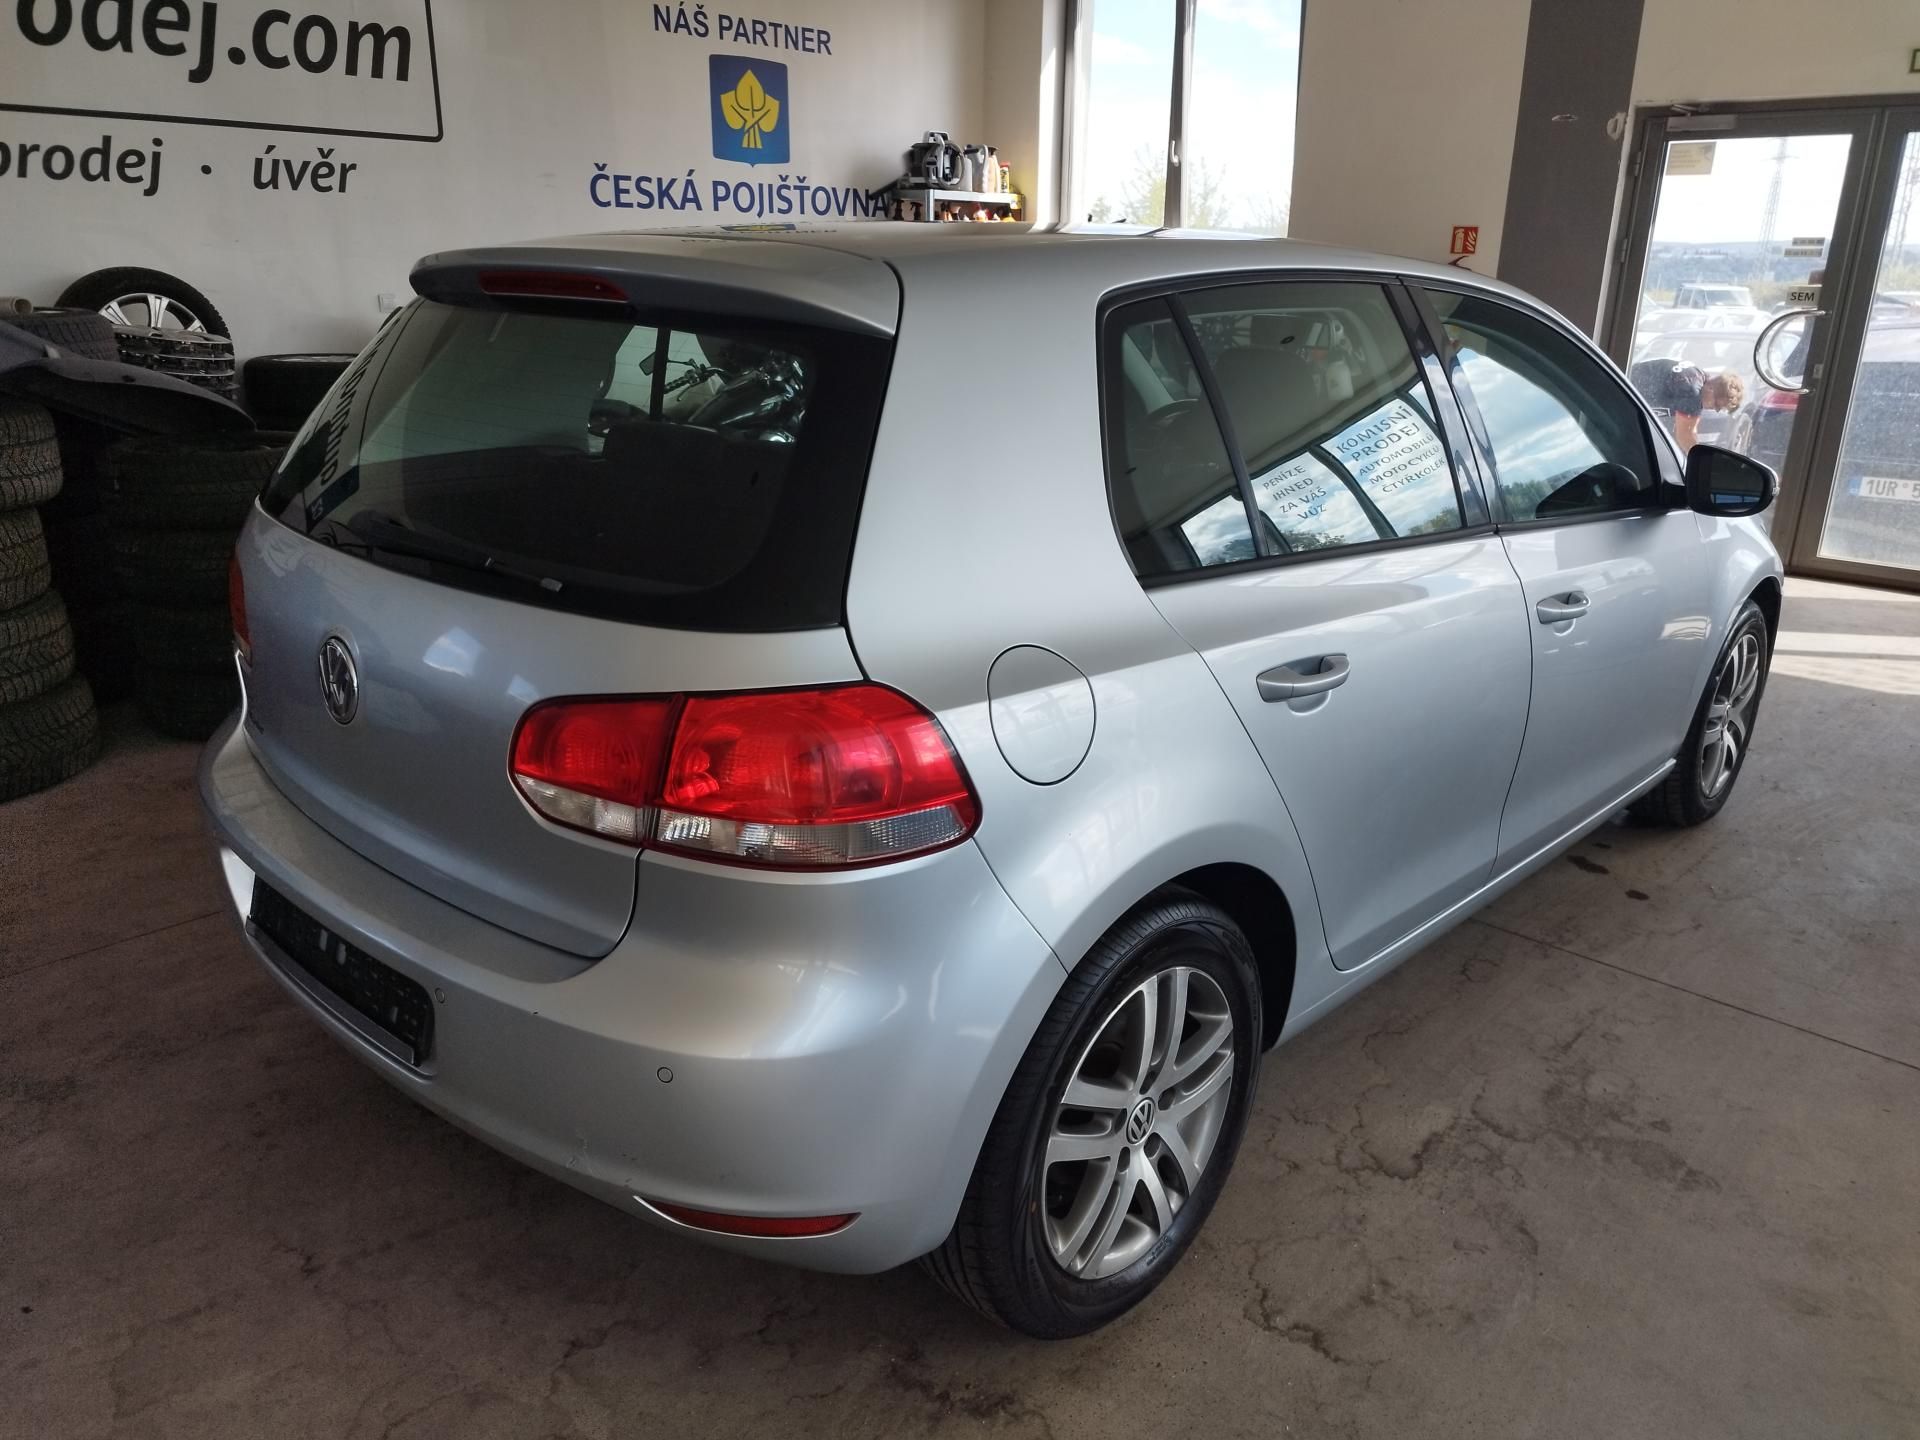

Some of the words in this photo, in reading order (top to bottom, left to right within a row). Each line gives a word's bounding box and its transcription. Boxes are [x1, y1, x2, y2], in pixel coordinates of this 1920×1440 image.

[653, 0, 710, 38] NÁŠ
[717, 14, 832, 56] PARTNER
[253, 144, 357, 194] úvěr
[589, 162, 703, 212] ČESKÁ
[711, 174, 889, 219] POJIŠŤOVNA
[1789, 291, 1815, 302] SEM
[1336, 405, 1413, 454] KOMISNÍ
[1351, 422, 1420, 462] PRODEJ
[1273, 477, 1314, 501] IHNED
[1280, 501, 1299, 514] ZA
[1299, 486, 1327, 504] VÁŠ
[1866, 479, 1898, 497] 1UR
